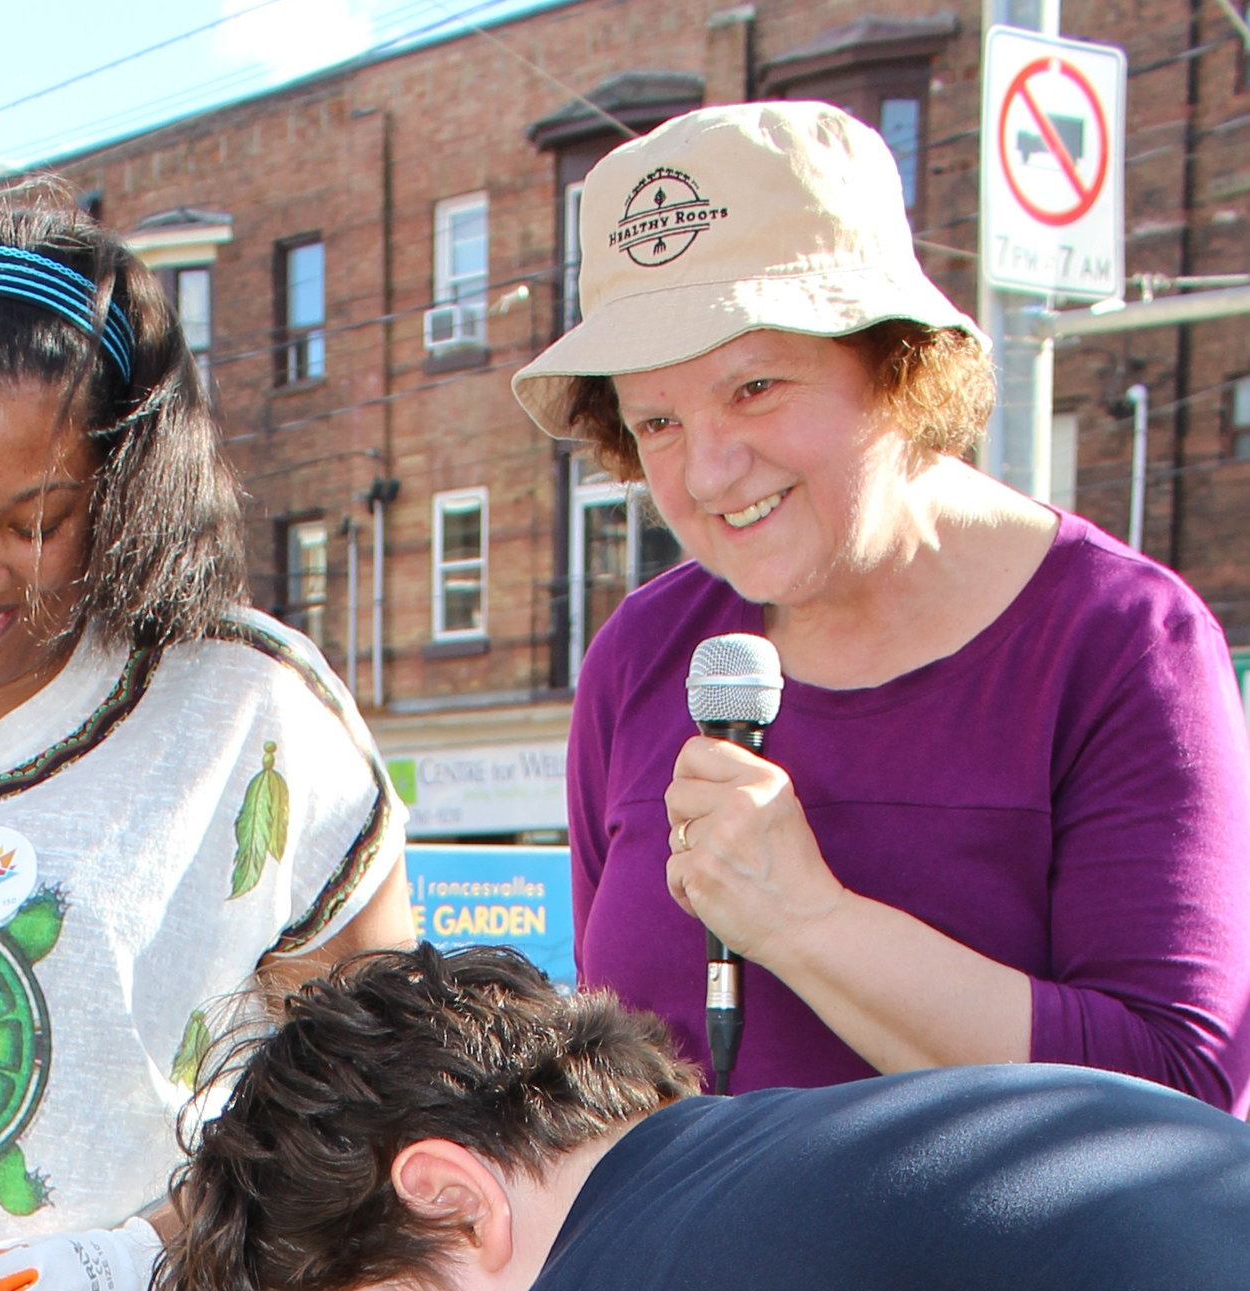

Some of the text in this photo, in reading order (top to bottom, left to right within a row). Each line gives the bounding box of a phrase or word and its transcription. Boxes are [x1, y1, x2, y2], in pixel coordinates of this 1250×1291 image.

[609, 208, 728, 247] HEALTHY ROOTS
[428, 875, 546, 897] roncesvalles
[432, 904, 546, 936] GARDEN
